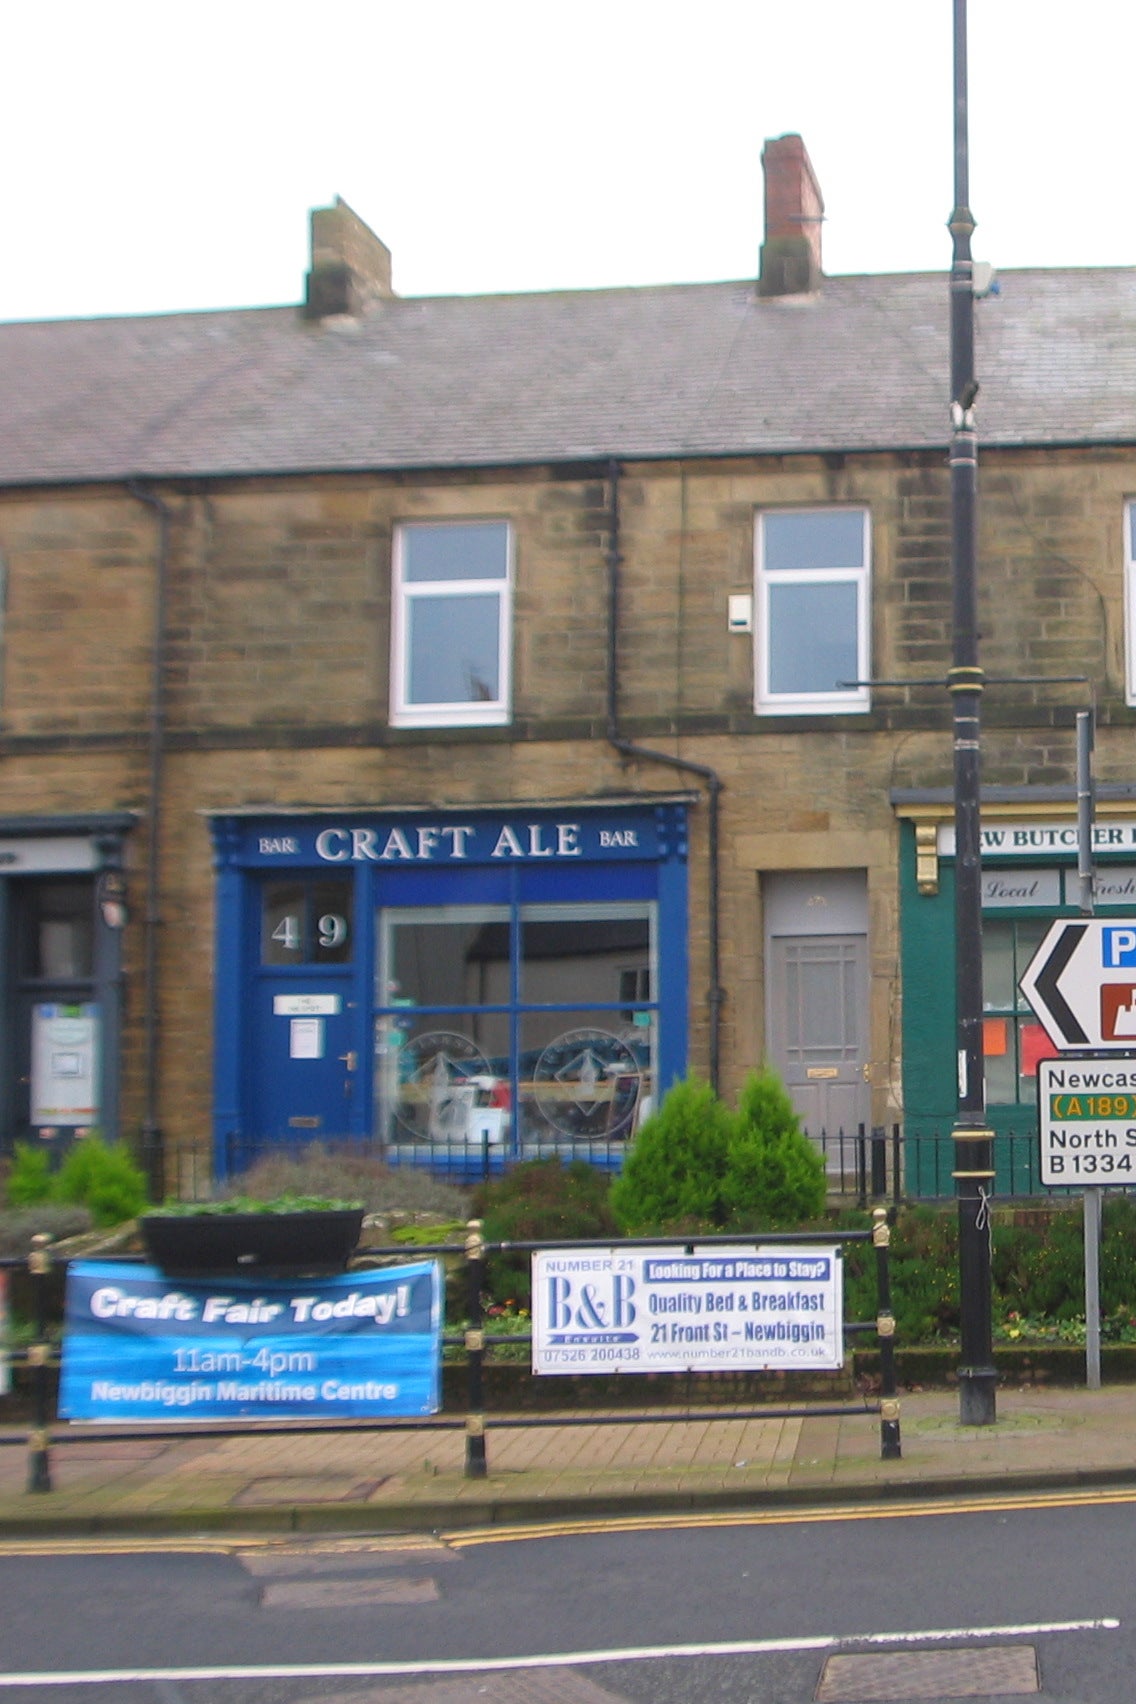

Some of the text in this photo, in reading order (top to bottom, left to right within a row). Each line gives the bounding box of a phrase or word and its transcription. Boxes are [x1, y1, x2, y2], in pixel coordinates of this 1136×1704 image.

[258, 823, 639, 861] BAR CRAFT ALE BAR
[1012, 827, 1124, 847] BUTCER
[986, 879, 1041, 899] Local
[1090, 876, 1136, 898] resh
[1110, 929, 1136, 966] P
[1049, 1130, 1118, 1148] North
[546, 1259, 634, 1272] NUMBER 21
[649, 1260, 826, 1280] Looking For a Place to Stay?
[90, 1285, 410, 1325] Craft Fair Today!
[547, 1274, 637, 1330] B&B
[648, 1290, 825, 1315] Quality Bed & Breakfast
[650, 1322, 667, 1343] 21
[669, 1322, 710, 1342] Front
[713, 1321, 728, 1342] St
[744, 1319, 825, 1343] Newbiggin
[171, 1347, 318, 1378] 11am-4pm
[543, 1347, 640, 1362] 07526 200438
[91, 1379, 399, 1406] Newbiggin Maritime Centre
